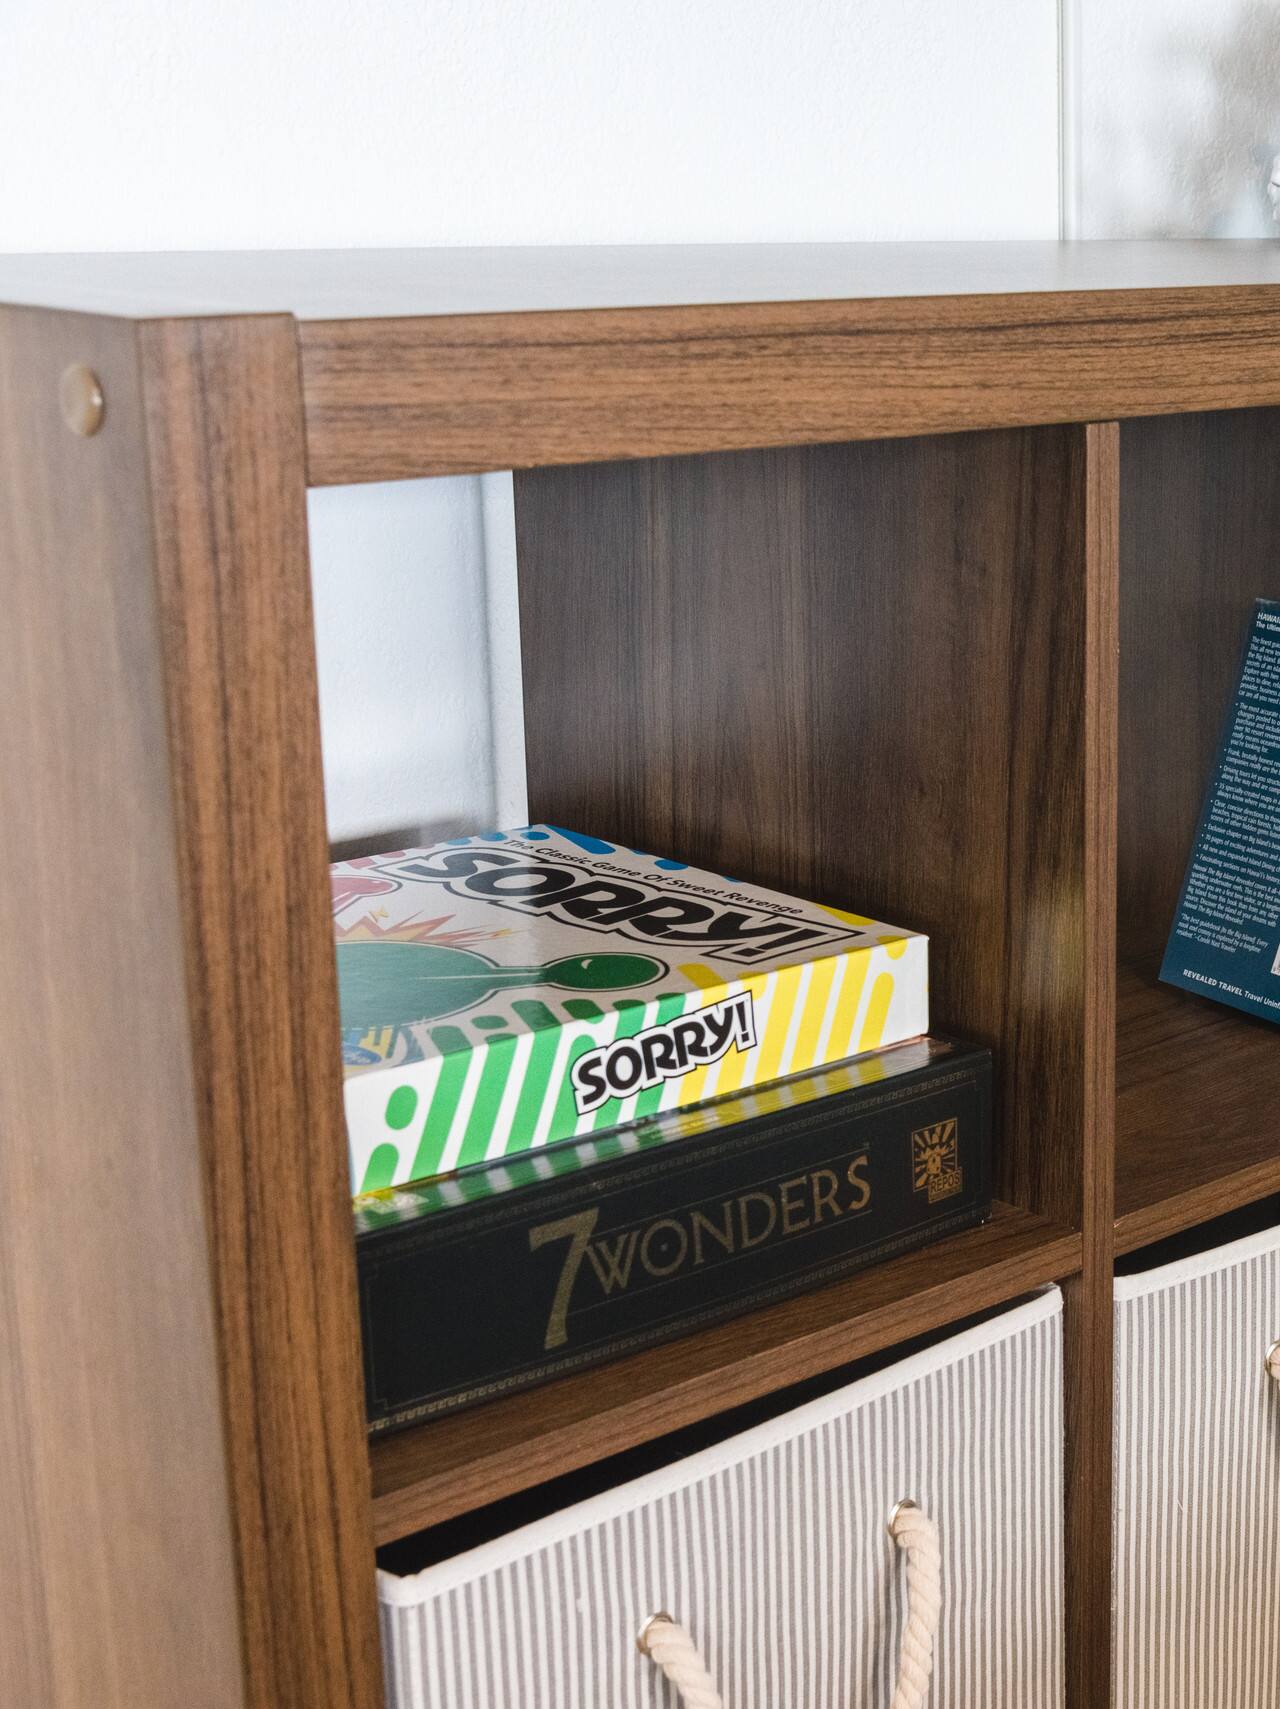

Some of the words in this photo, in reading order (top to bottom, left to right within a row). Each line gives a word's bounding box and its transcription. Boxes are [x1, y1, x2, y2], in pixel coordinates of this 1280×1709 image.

[1255, 620, 1266, 628] The
[397, 852, 830, 957] SORRY!
[503, 839, 534, 851] The
[535, 846, 594, 866] Classic
[591, 860, 642, 879] Game
[644, 870, 669, 884] Of
[668, 877, 724, 897] Sweet
[724, 889, 804, 916] Revenge
[1182, 968, 1218, 986] REVEALED
[1218, 981, 1244, 995] TRAVEL
[1244, 990, 1263, 1002] Travel
[578, 1001, 750, 1105] SORRY!
[930, 1171, 961, 1193] REPOS
[529, 1206, 600, 1350] 7
[586, 1154, 872, 1294] WONDERS
